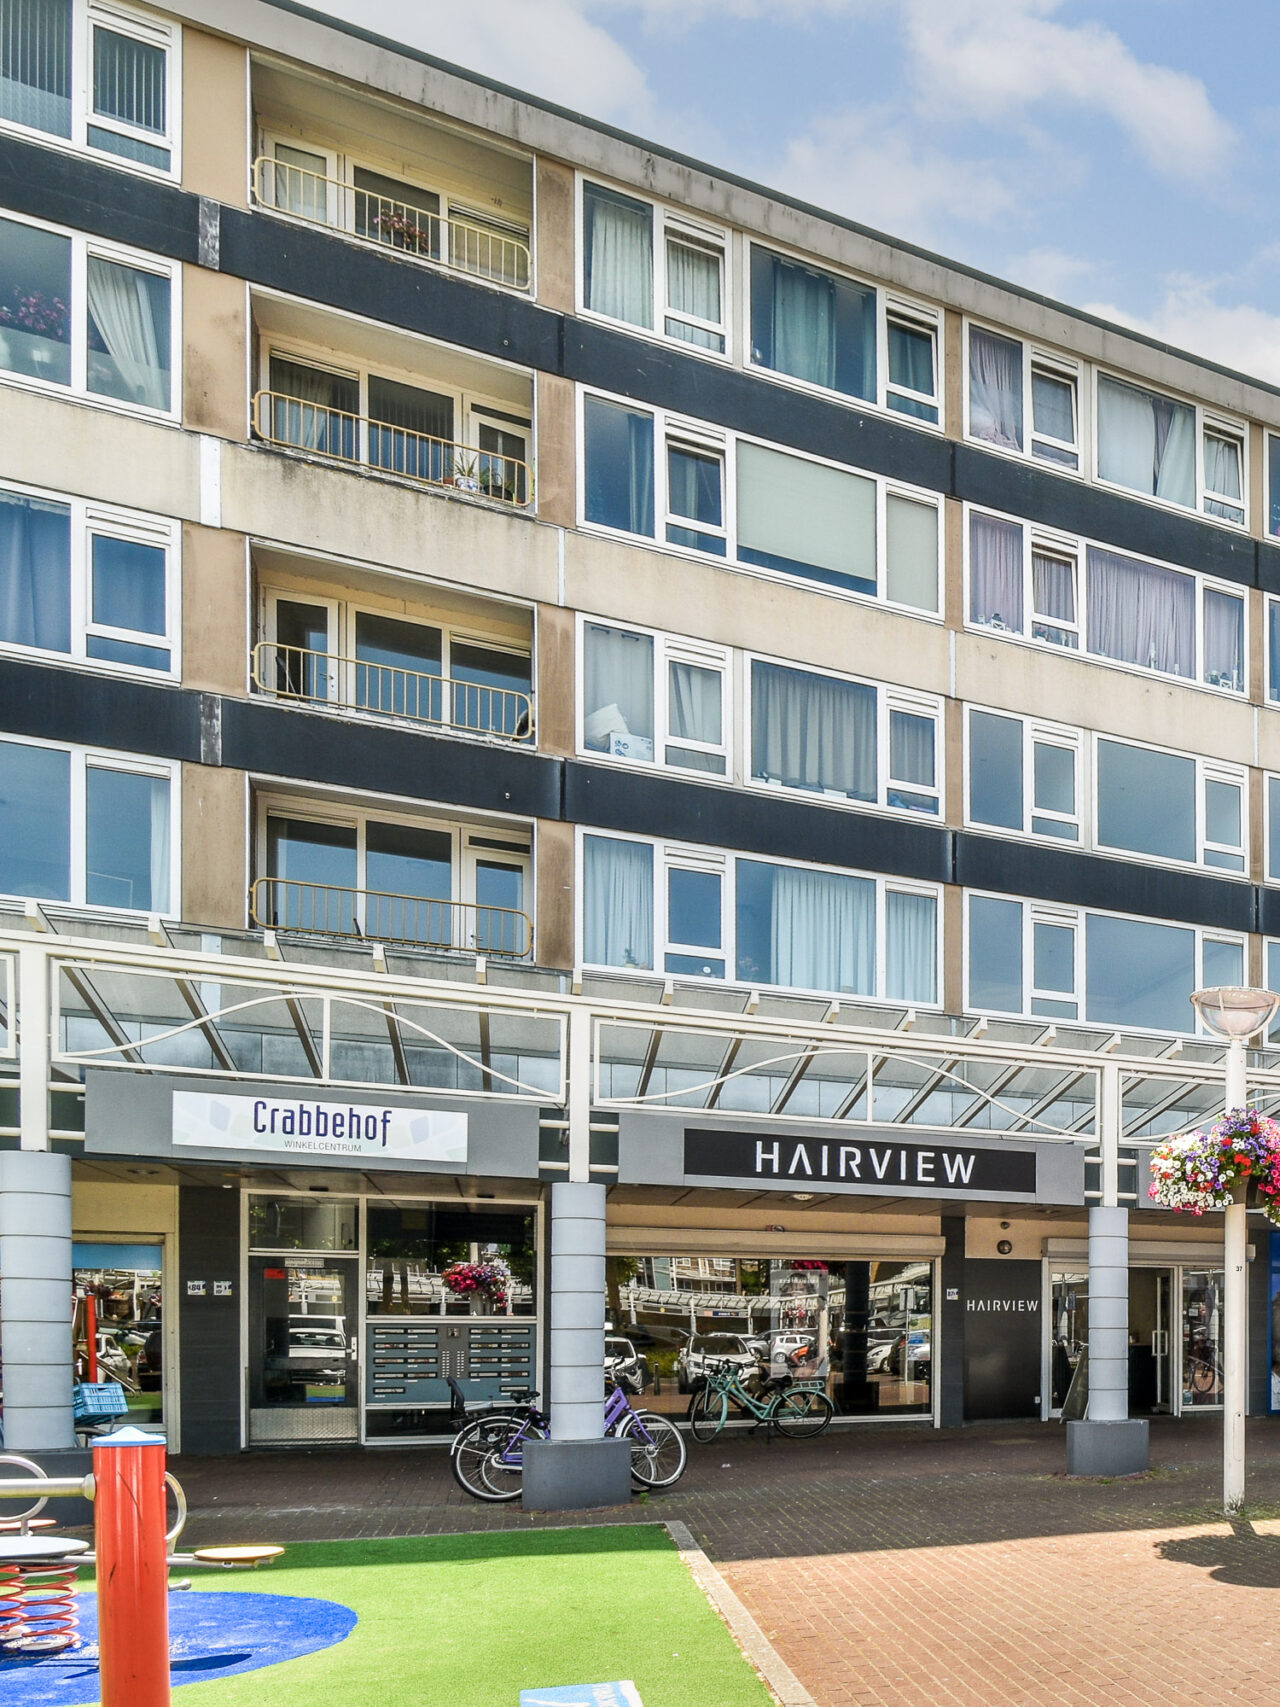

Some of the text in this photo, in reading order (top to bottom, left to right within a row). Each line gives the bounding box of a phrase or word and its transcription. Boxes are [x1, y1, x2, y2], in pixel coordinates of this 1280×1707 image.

[253, 1100, 393, 1147] Crabbehof
[284, 1140, 362, 1153] WINKELCENTRUM
[755, 1140, 976, 1184] HAIRVIEW
[966, 1299, 1039, 1312] HAIRVIEW
